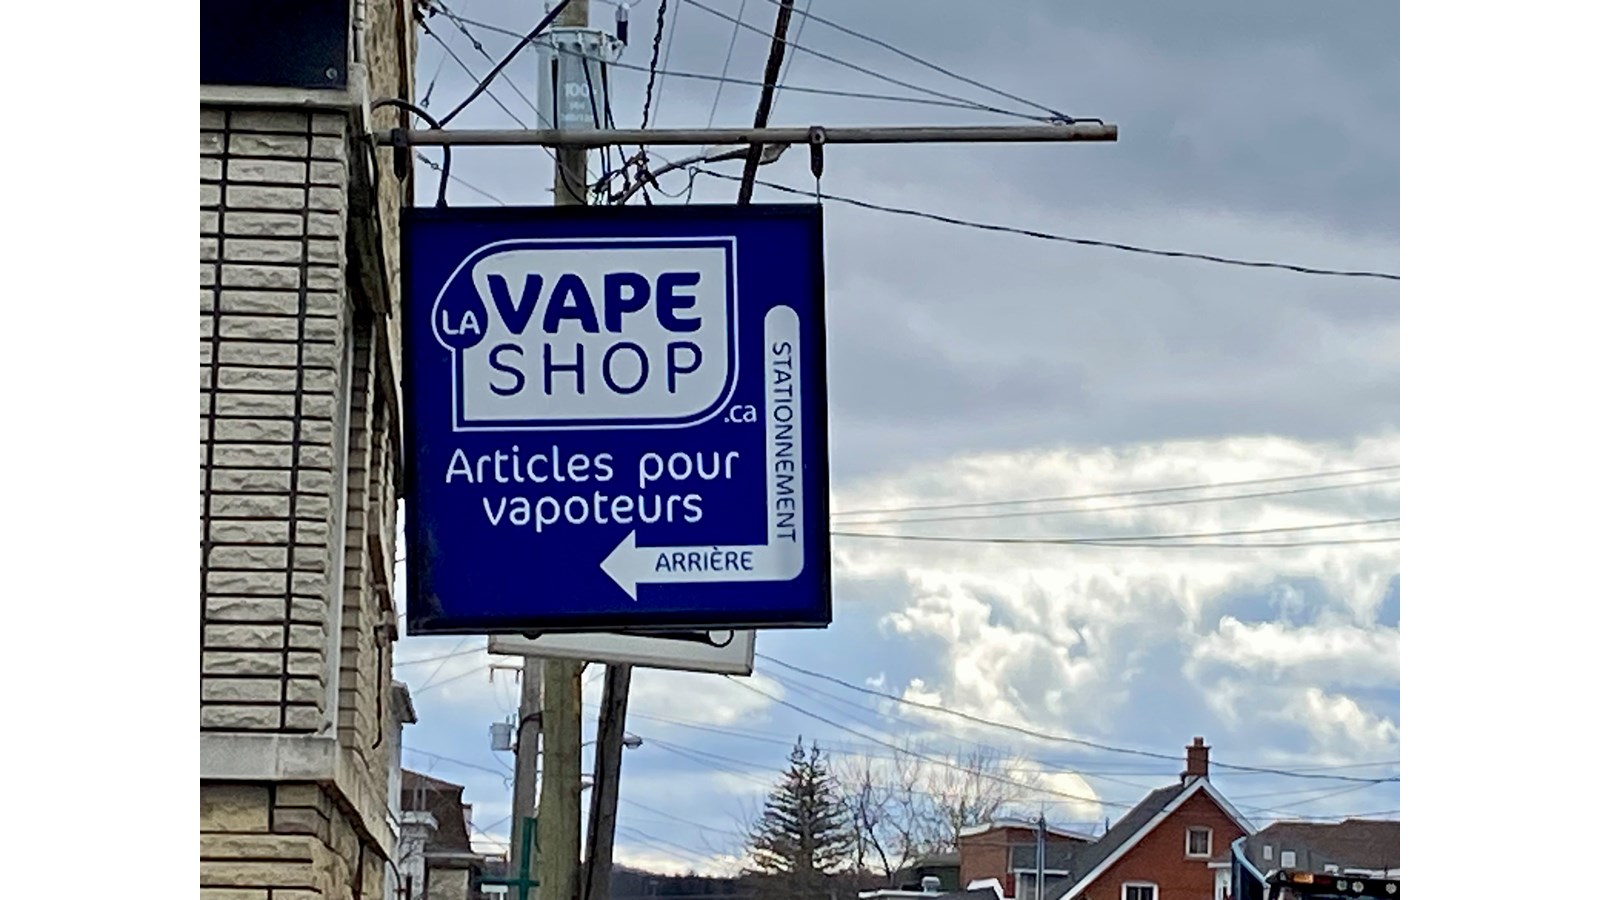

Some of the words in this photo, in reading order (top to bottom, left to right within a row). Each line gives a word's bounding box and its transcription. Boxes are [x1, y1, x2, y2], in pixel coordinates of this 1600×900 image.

[442, 310, 481, 336] LA
[487, 272, 702, 335] VAPE
[488, 341, 703, 396] SHOP
[723, 403, 757, 424] .ca
[772, 341, 797, 543] STATIONNEMENT
[445, 445, 614, 484] Articles
[639, 450, 740, 489] pour
[482, 490, 703, 533] vapoteurs
[655, 545, 754, 573] ARRIÈRE
